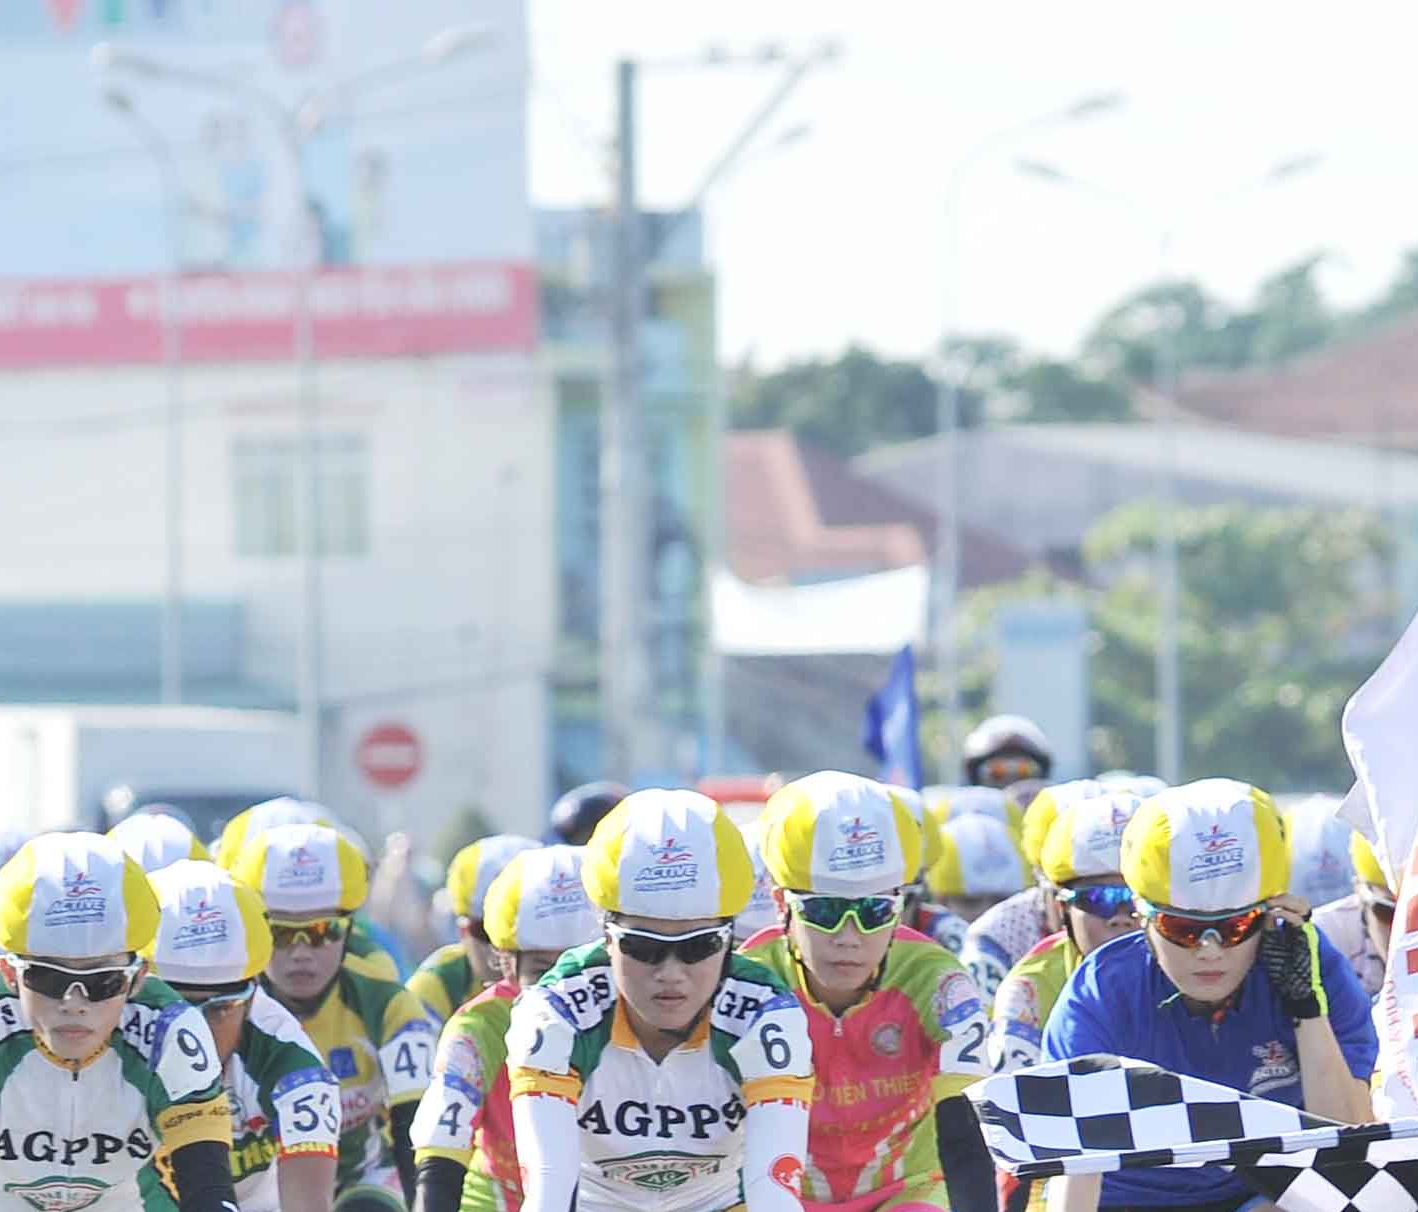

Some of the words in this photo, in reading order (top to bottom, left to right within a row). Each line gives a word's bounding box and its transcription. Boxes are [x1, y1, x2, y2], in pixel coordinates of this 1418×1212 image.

[178, 1028, 208, 1071] 9
[760, 1024, 791, 1069] 6
[577, 1093, 748, 1140] AGPPS
